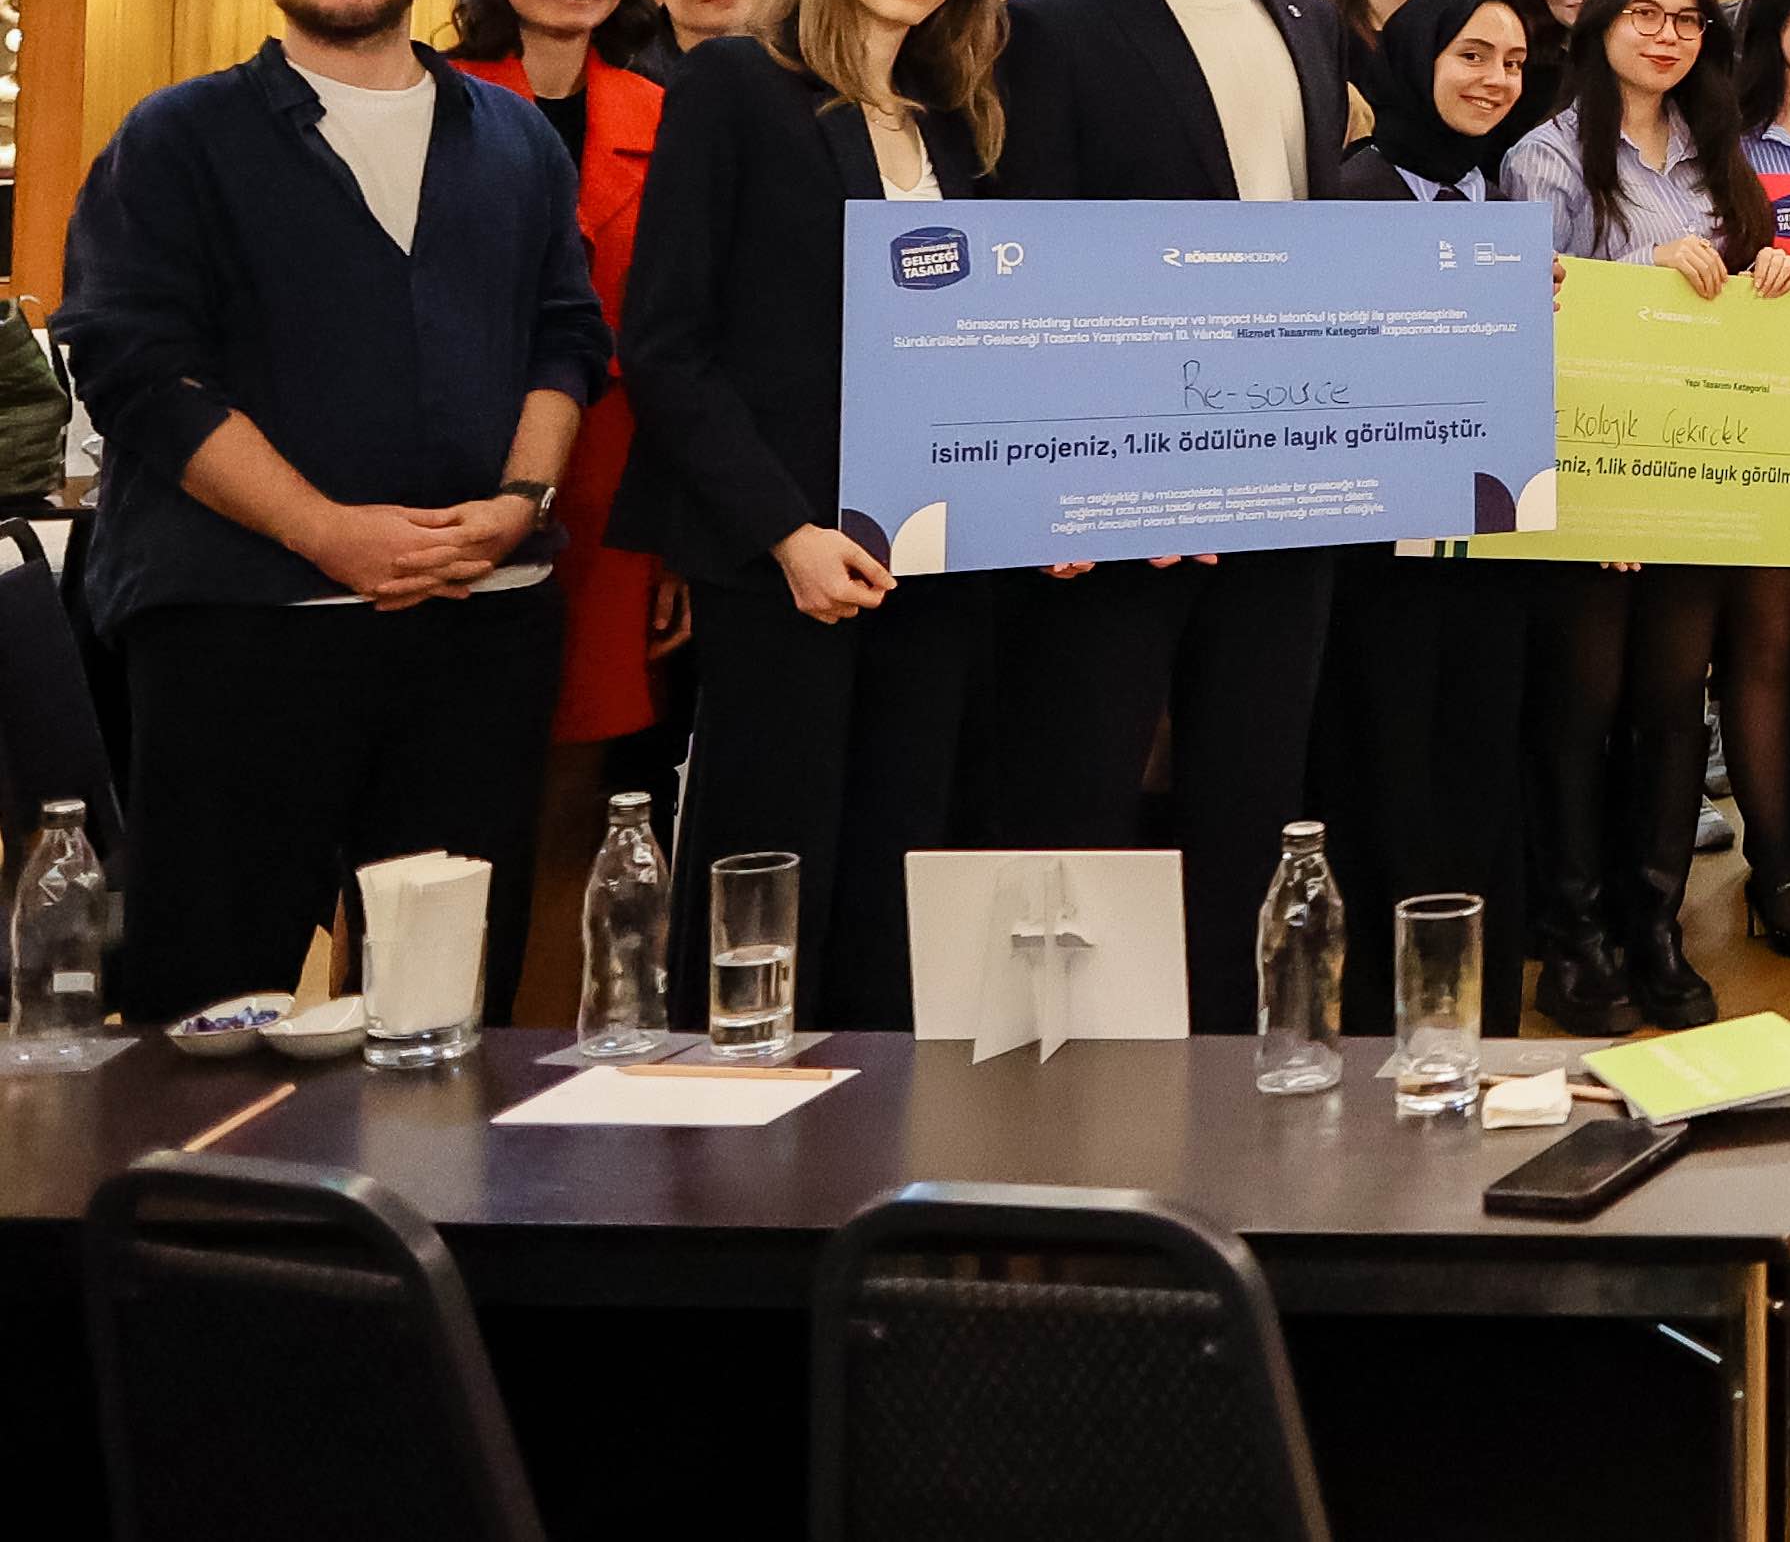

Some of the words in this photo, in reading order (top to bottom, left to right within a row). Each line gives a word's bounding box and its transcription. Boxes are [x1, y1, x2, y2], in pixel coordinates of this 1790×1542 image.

[901, 249, 959, 268] GELECEĞİ
[903, 262, 960, 279] TASARLA
[1236, 328, 1276, 339] Hizmet
[1325, 325, 1380, 339] Kategorisi
[932, 440, 997, 463] isimli
[1007, 435, 1116, 465] projeniz,
[1123, 432, 1171, 454] 1.lik
[1179, 429, 1276, 451] ödülüne
[1285, 425, 1337, 450] layık
[1345, 419, 1486, 448] görülmüştür.
[1595, 456, 1627, 476] 1.lik
[1631, 458, 1697, 479] ödülüne
[1700, 462, 1738, 485] layık
